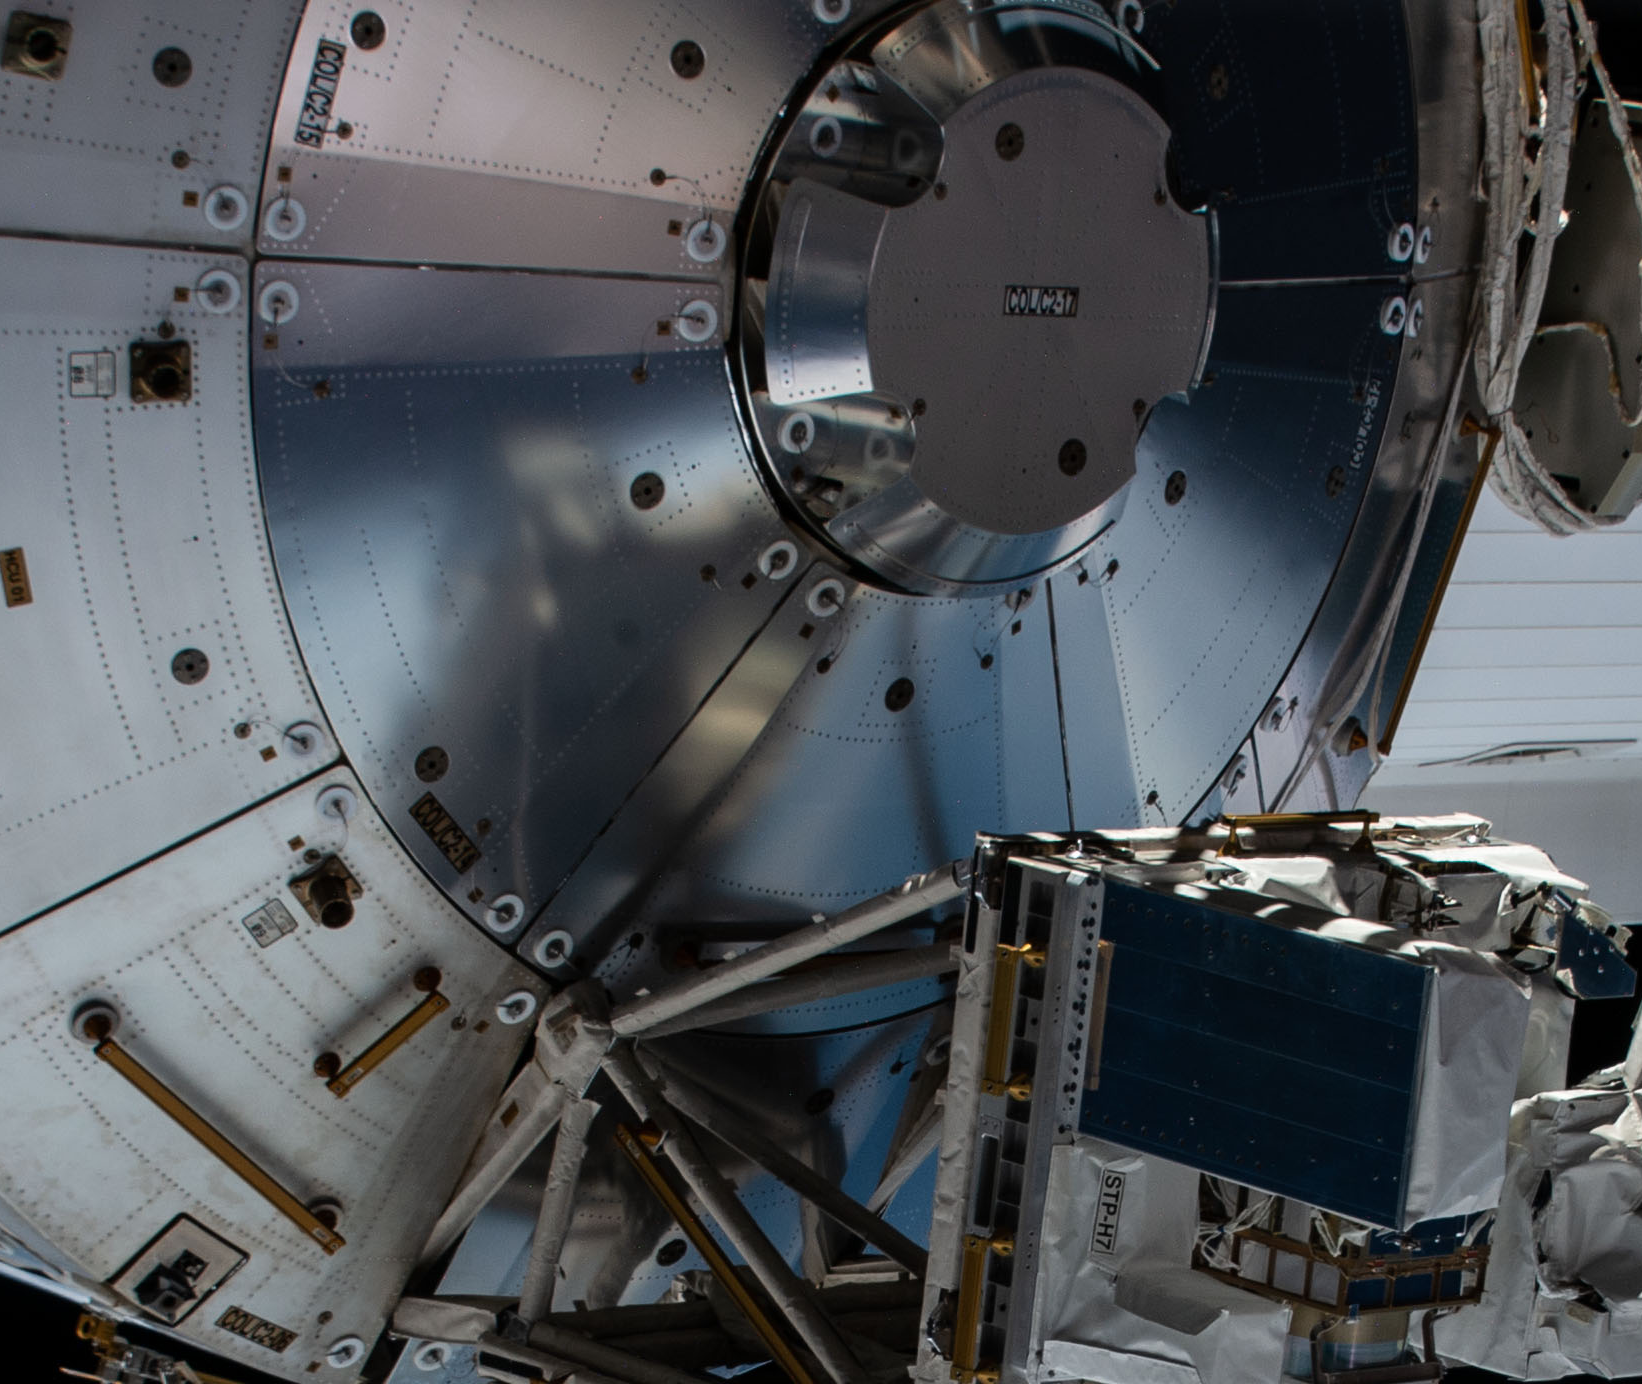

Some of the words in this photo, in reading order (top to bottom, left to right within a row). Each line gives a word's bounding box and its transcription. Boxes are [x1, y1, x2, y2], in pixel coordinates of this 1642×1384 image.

[297, 46, 344, 143] COL/C2-15
[1008, 286, 1077, 314] COL/C2-17
[5, 550, 21, 583] HCU
[1095, 1175, 1122, 1250] STP-H7
